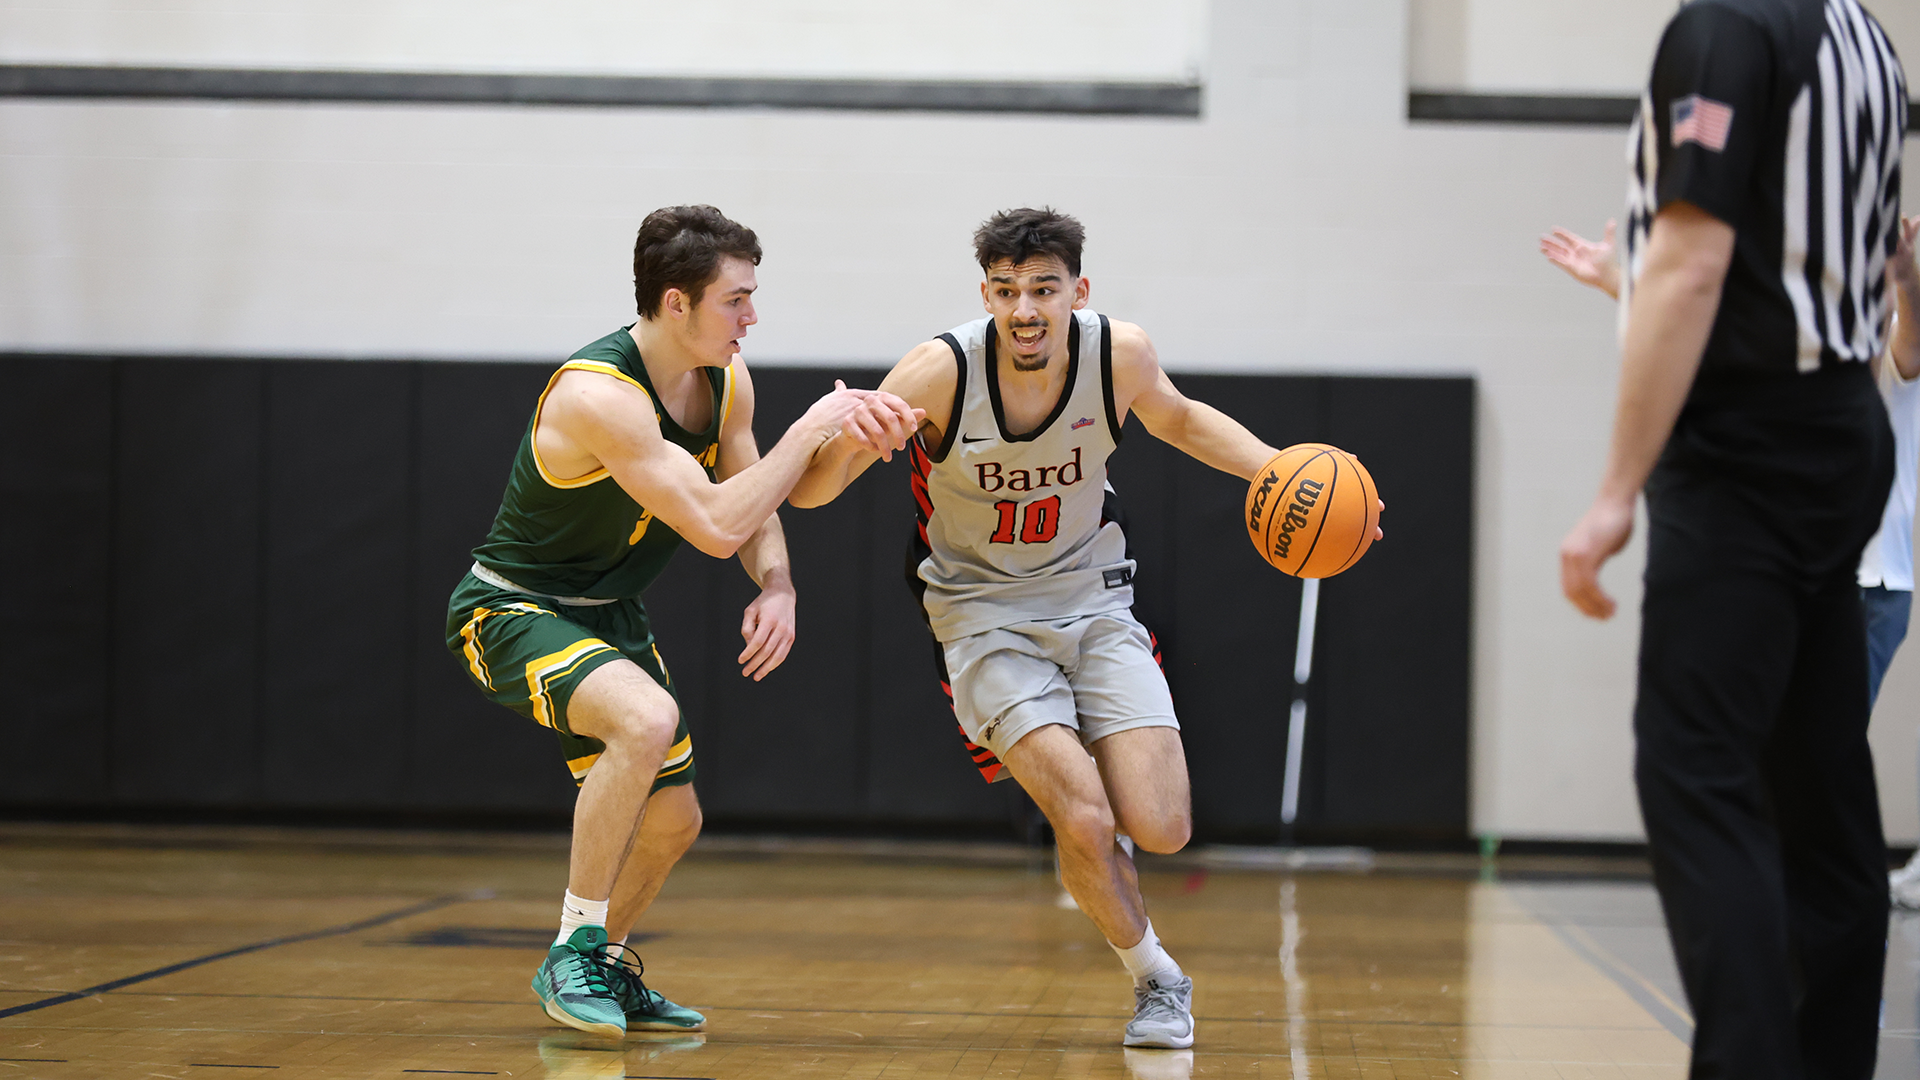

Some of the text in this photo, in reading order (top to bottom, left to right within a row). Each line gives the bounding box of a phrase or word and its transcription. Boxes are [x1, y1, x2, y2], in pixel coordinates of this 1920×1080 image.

[974, 446, 1084, 492] Bard
[989, 494, 1062, 545] 10
[1249, 470, 1280, 533] NCAA
[1273, 477, 1326, 559] Wilson
